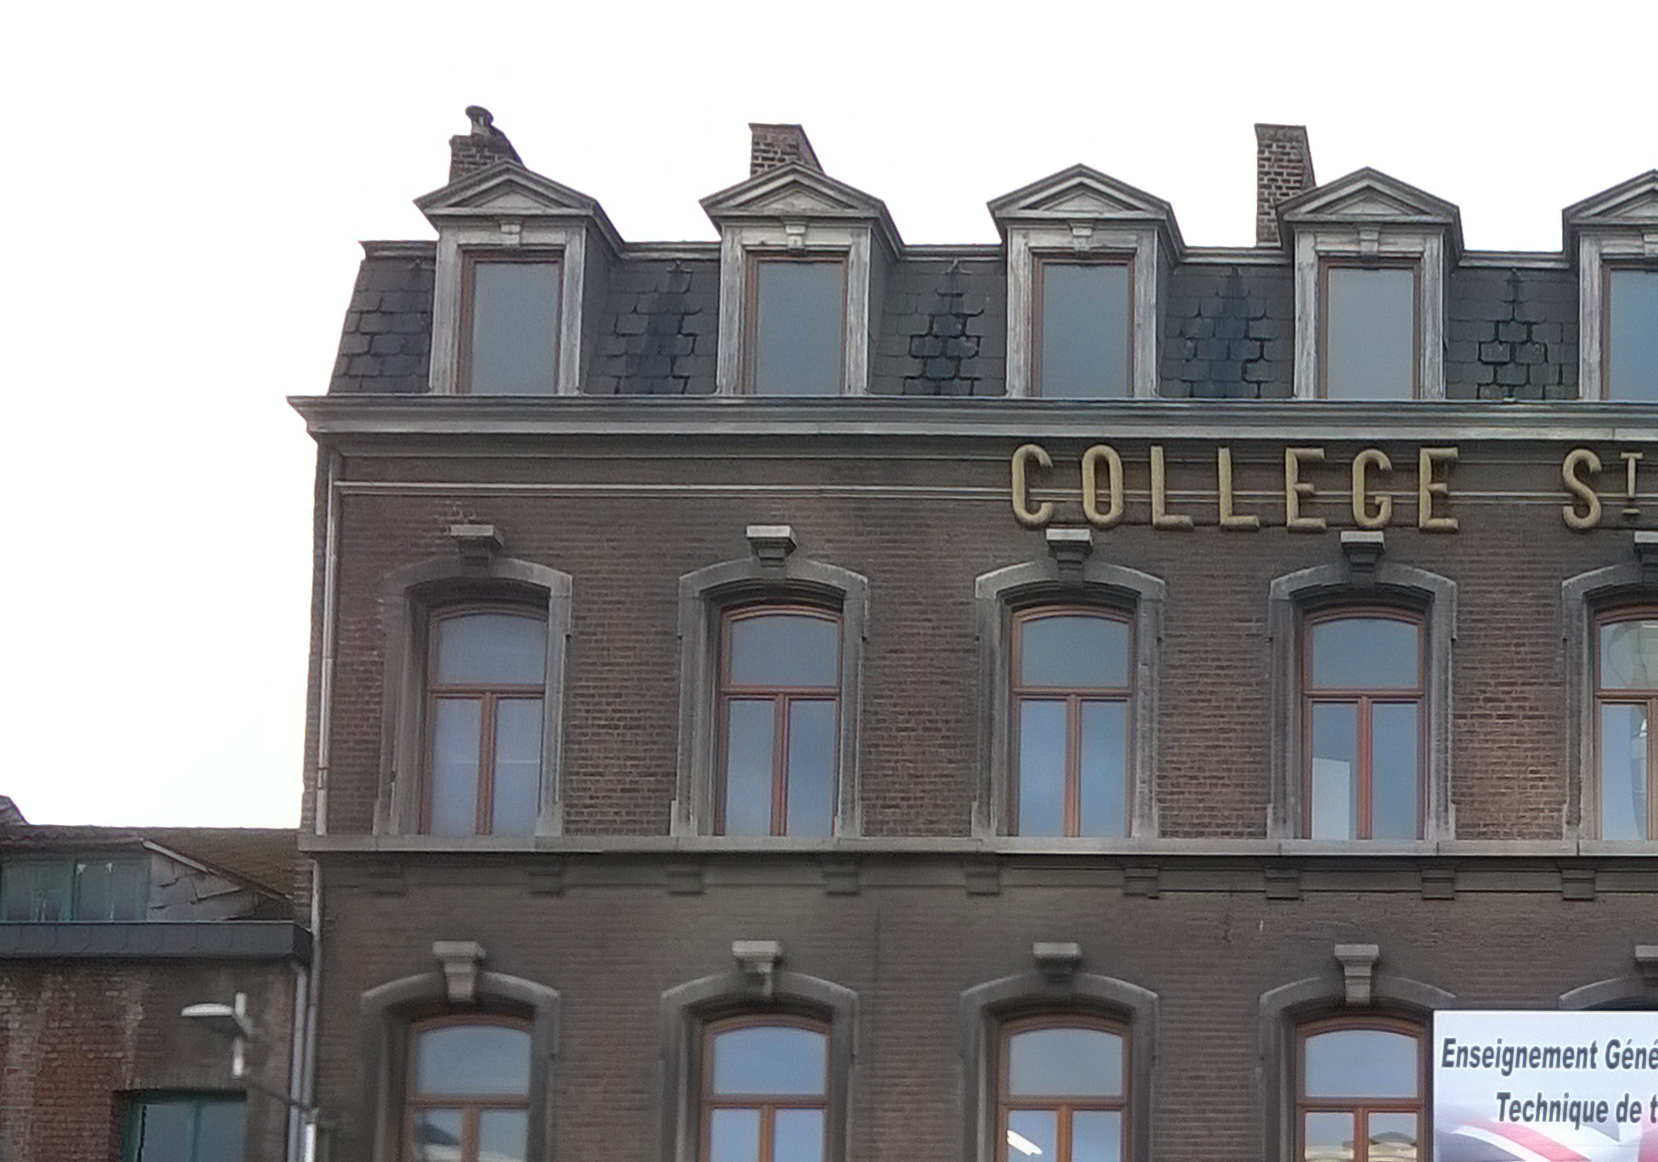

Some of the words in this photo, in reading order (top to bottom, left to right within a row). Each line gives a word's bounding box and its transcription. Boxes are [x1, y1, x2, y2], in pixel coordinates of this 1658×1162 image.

[1011, 443, 1459, 532] COLLEGE
[1441, 1037, 1598, 1076] Enseignement
[1496, 1092, 1609, 1130] Technique
[1616, 1093, 1642, 1123] de
